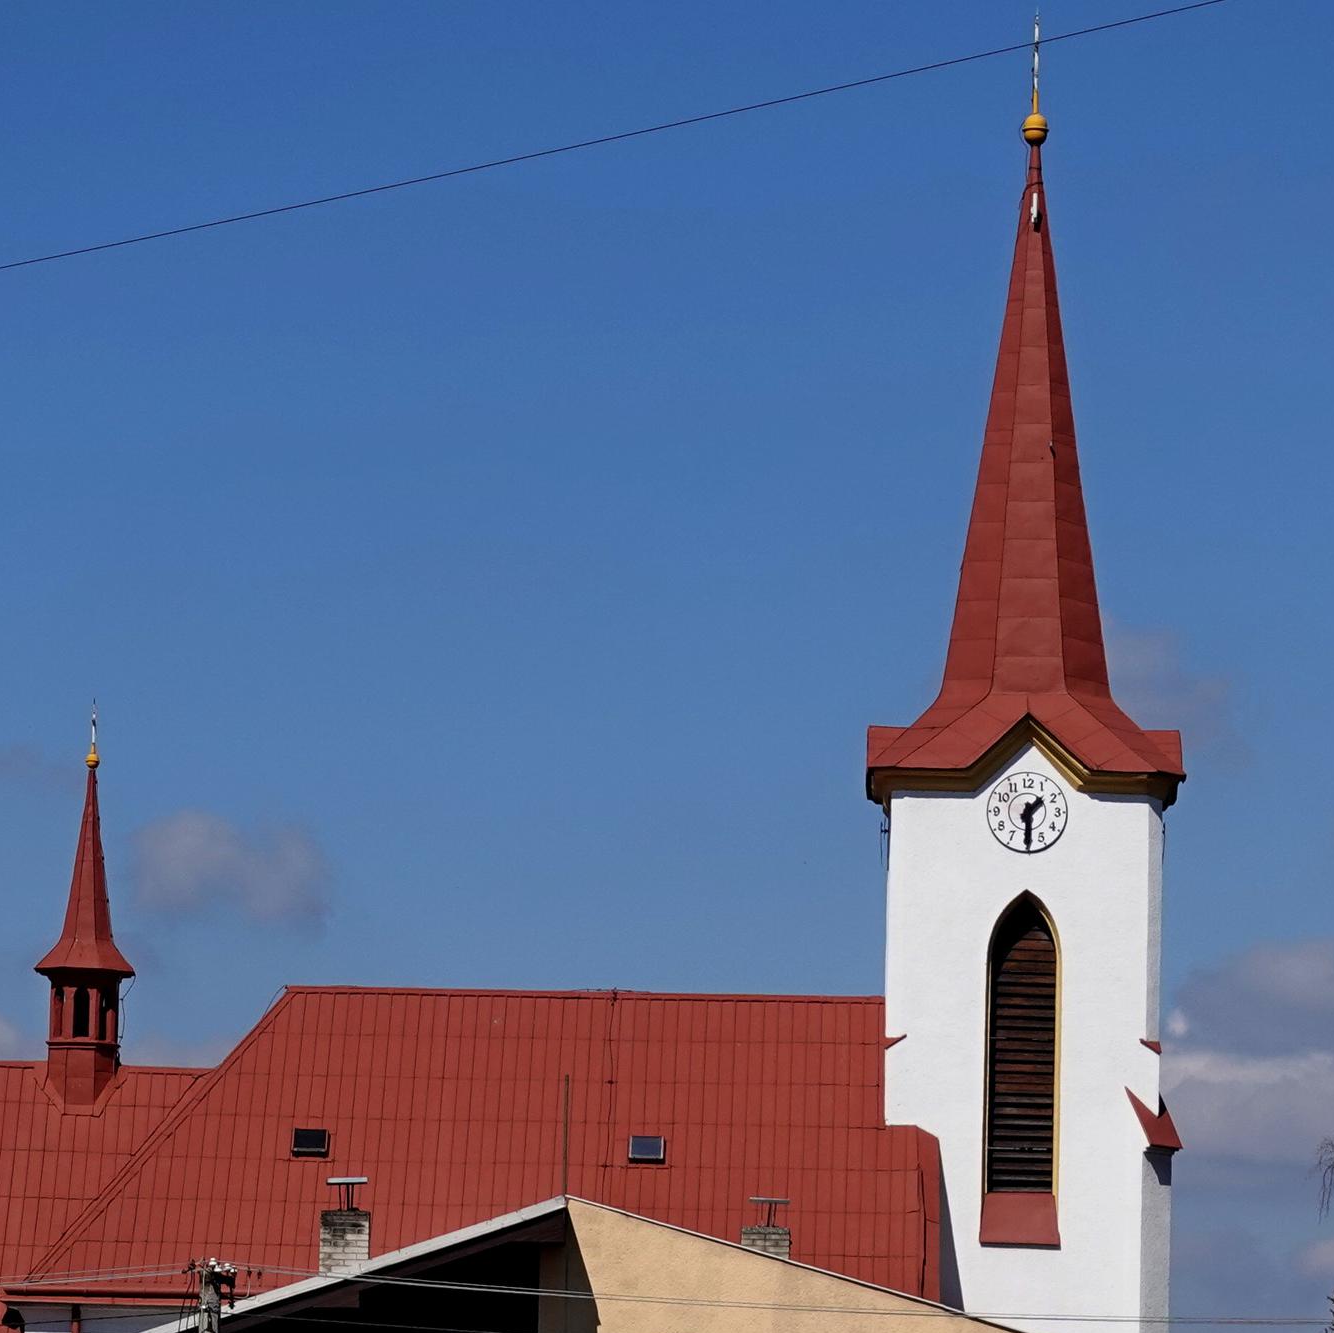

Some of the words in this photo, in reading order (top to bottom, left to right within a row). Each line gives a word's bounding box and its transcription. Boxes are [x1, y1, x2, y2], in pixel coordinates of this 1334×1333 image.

[1009, 782, 1018, 793] 11
[1023, 778, 1034, 789] 12
[998, 792, 1010, 803] 10
[1049, 793, 1057, 803] 2
[993, 806, 1000, 816] 9
[1054, 807, 1061, 817] 3
[998, 821, 1005, 831] 8
[1049, 821, 1056, 831] 4
[1009, 830, 1016, 841] 7
[1037, 832, 1045, 842] 5
